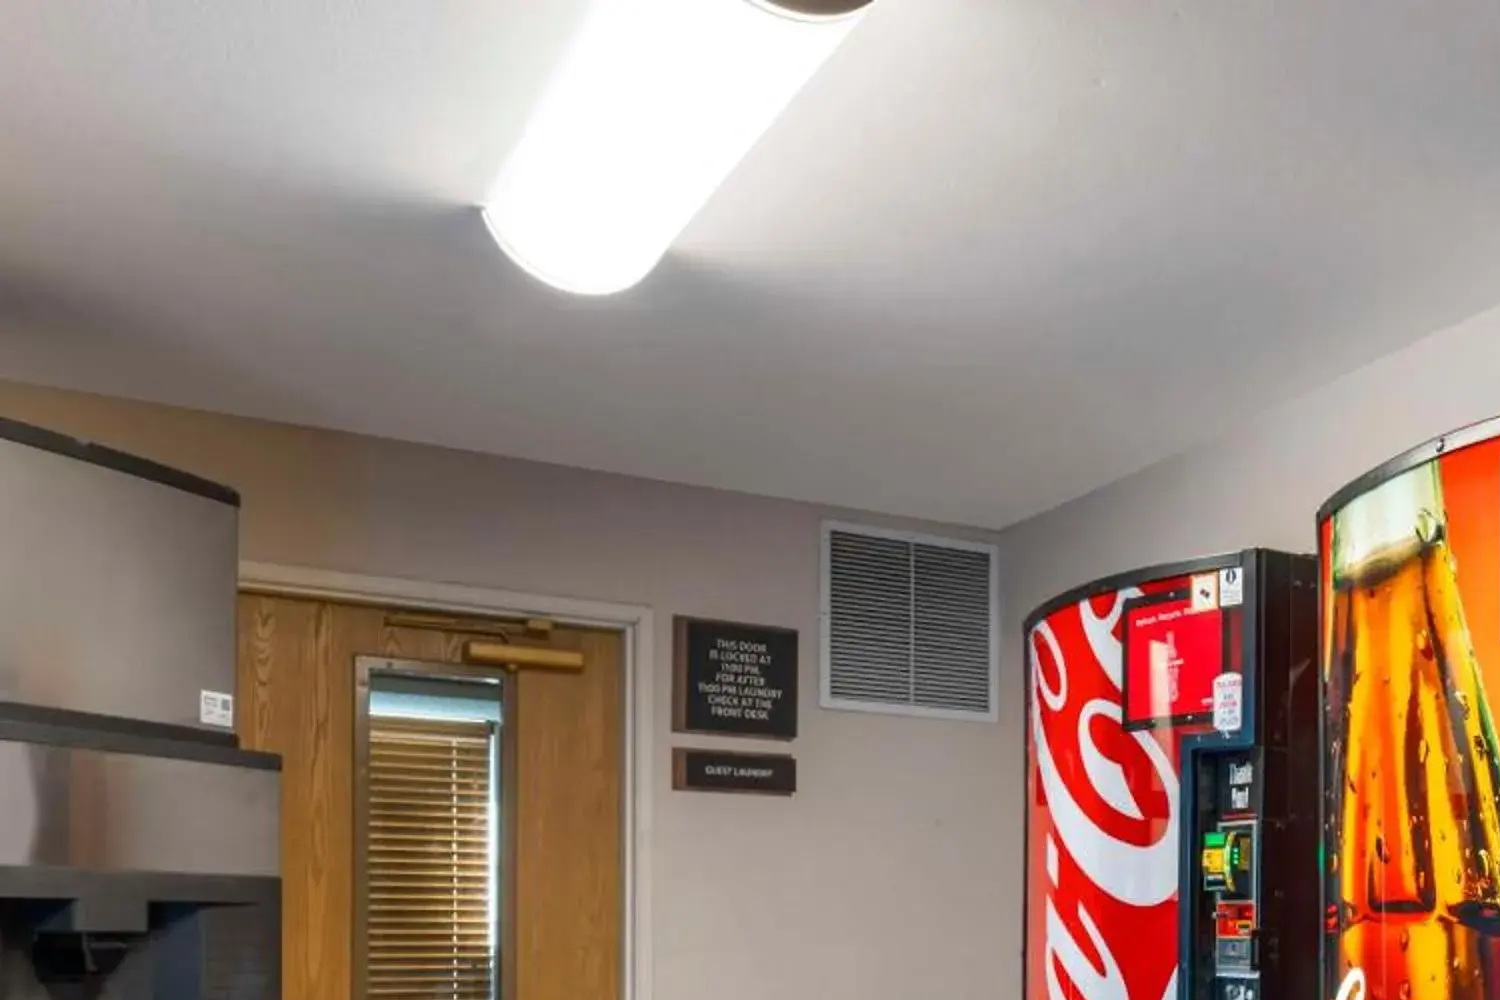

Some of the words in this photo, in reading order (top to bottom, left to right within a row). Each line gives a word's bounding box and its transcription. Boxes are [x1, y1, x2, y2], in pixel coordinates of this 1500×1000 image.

[717, 639, 738, 651] THIS
[739, 641, 767, 653] DOOR
[720, 651, 758, 664] LOCKED
[760, 655, 771, 666] AT
[737, 675, 765, 687] AFTER
[738, 686, 783, 700] LAUNDRY
[708, 695, 739, 706] CHECK
[711, 705, 742, 718] FRONT
[744, 708, 769, 720] DESK
[705, 765, 732, 776] GUEST
[733, 767, 774, 778] LAUNDRY
